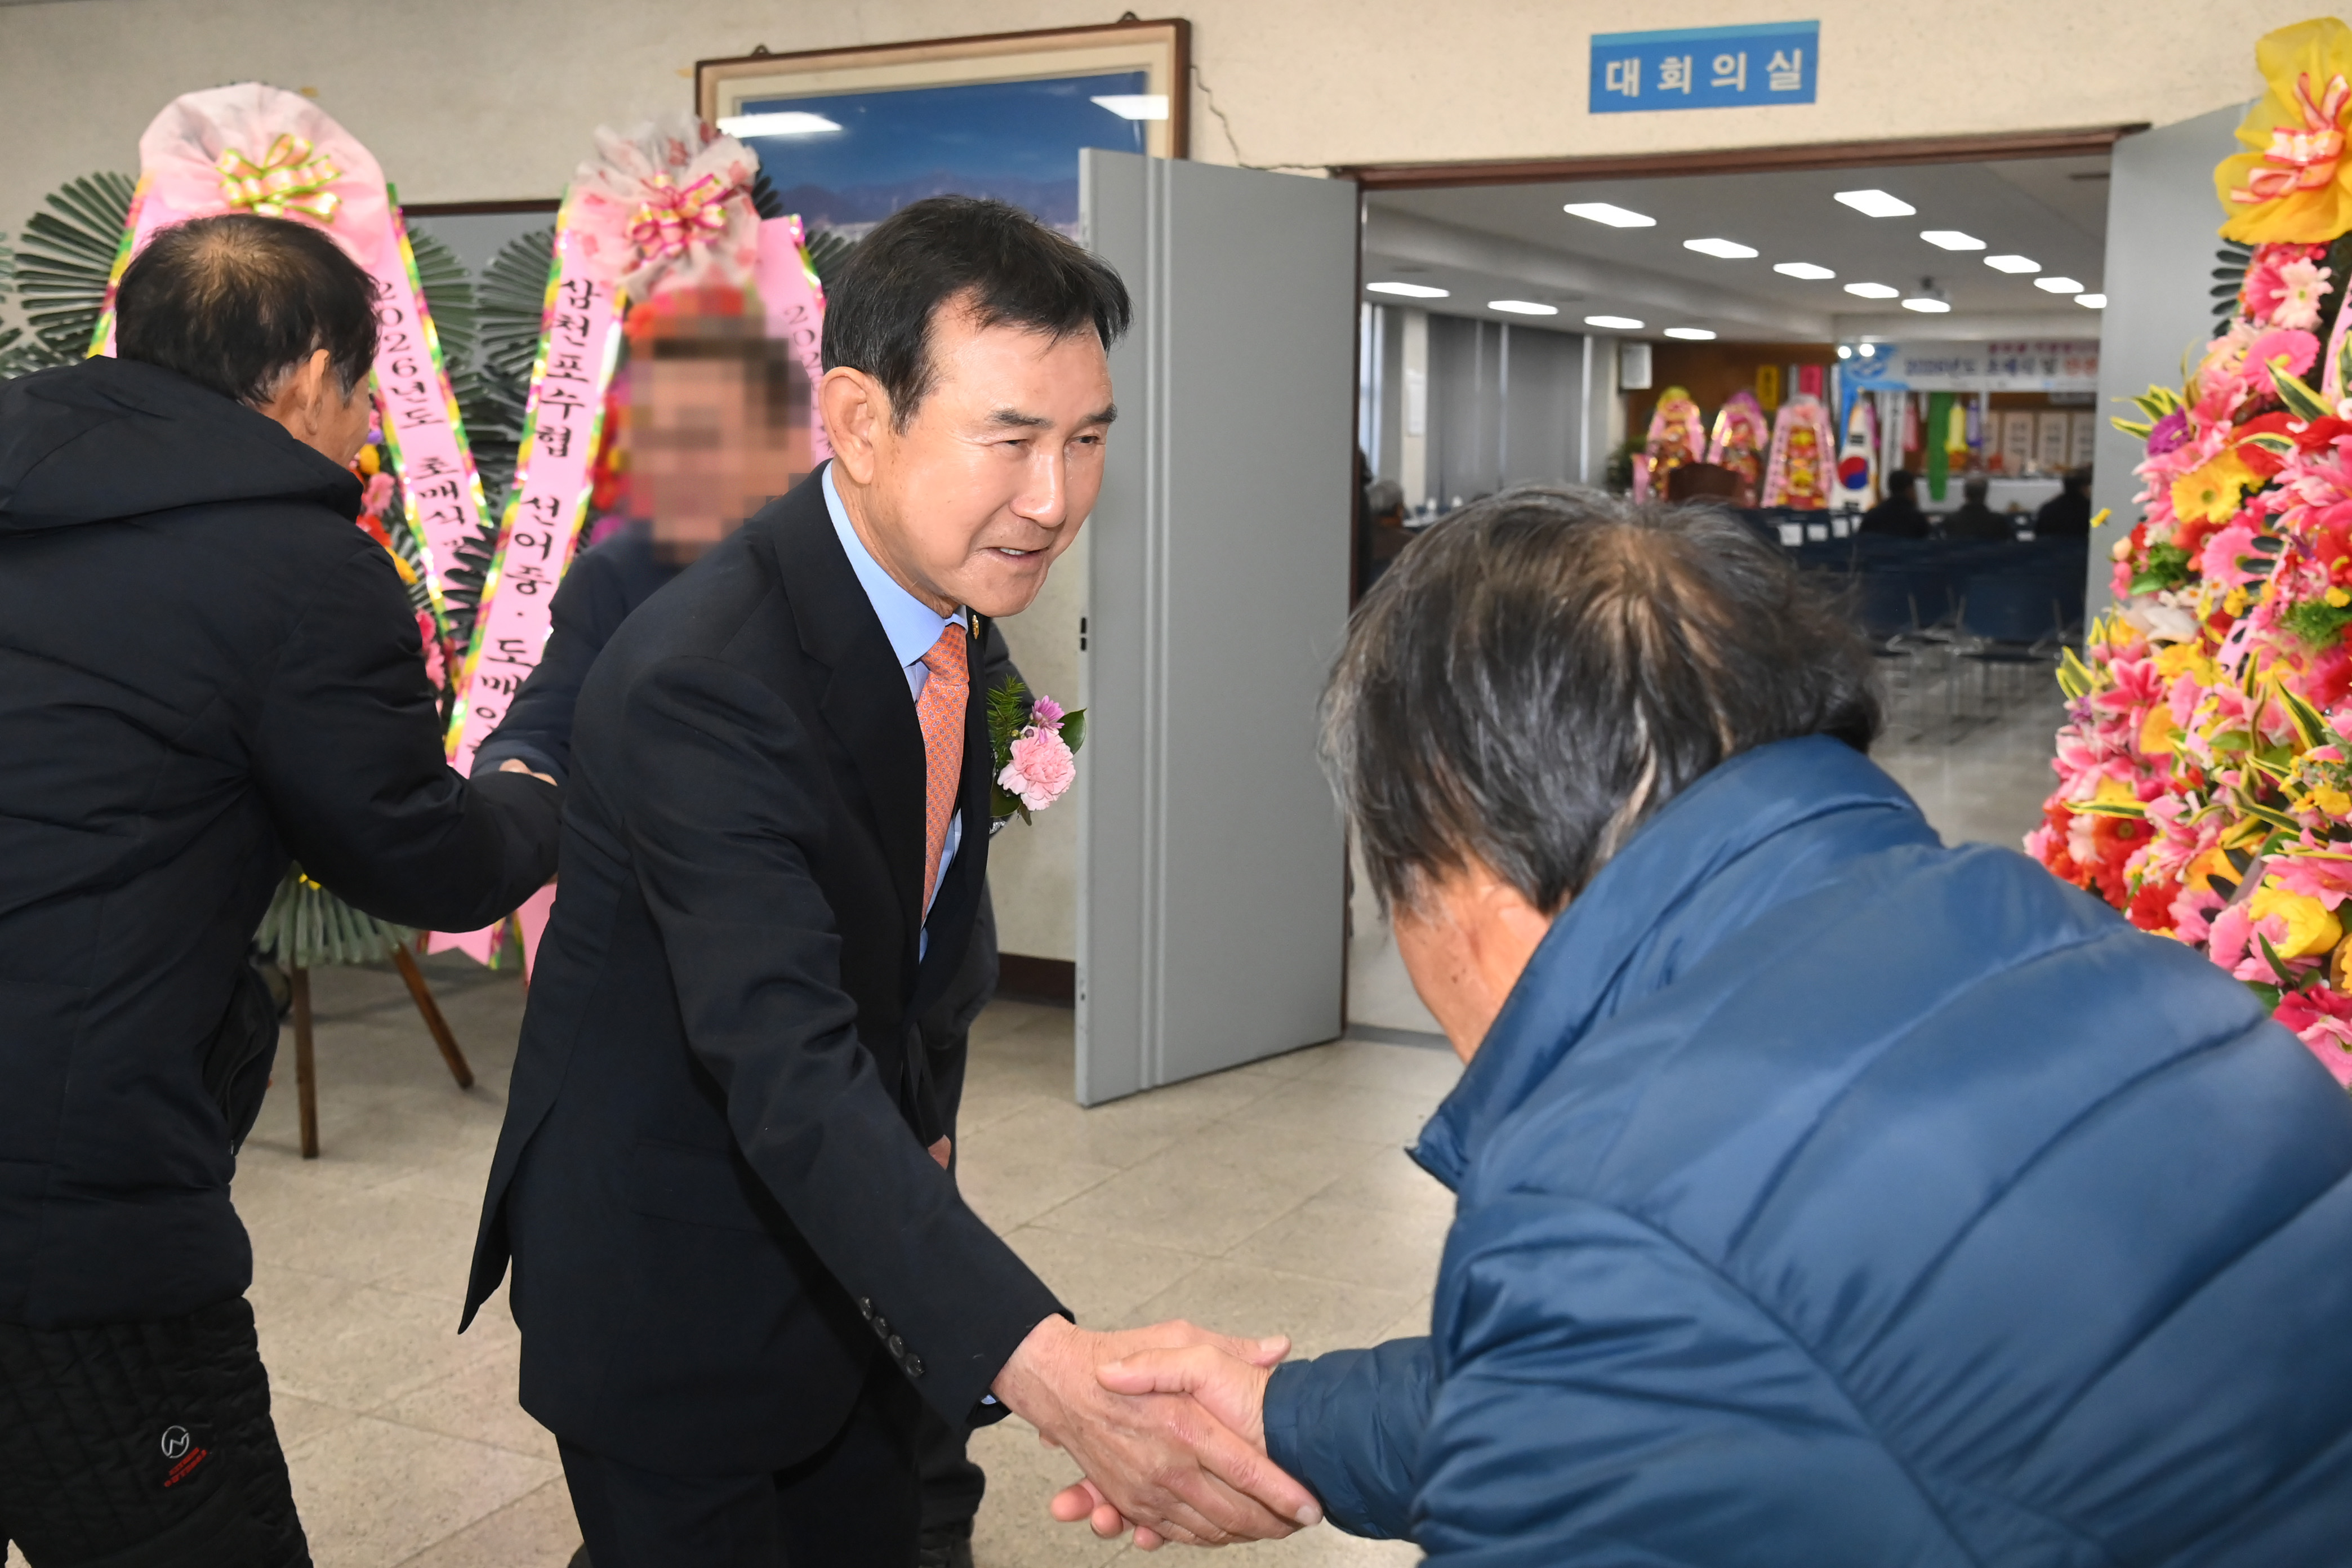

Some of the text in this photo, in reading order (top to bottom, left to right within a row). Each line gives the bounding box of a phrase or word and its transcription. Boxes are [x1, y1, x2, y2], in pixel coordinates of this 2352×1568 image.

[1604, 48, 1803, 98] 대회의실
[378, 282, 445, 430] 2026년도
[534, 279, 602, 458] 삼천포수협
